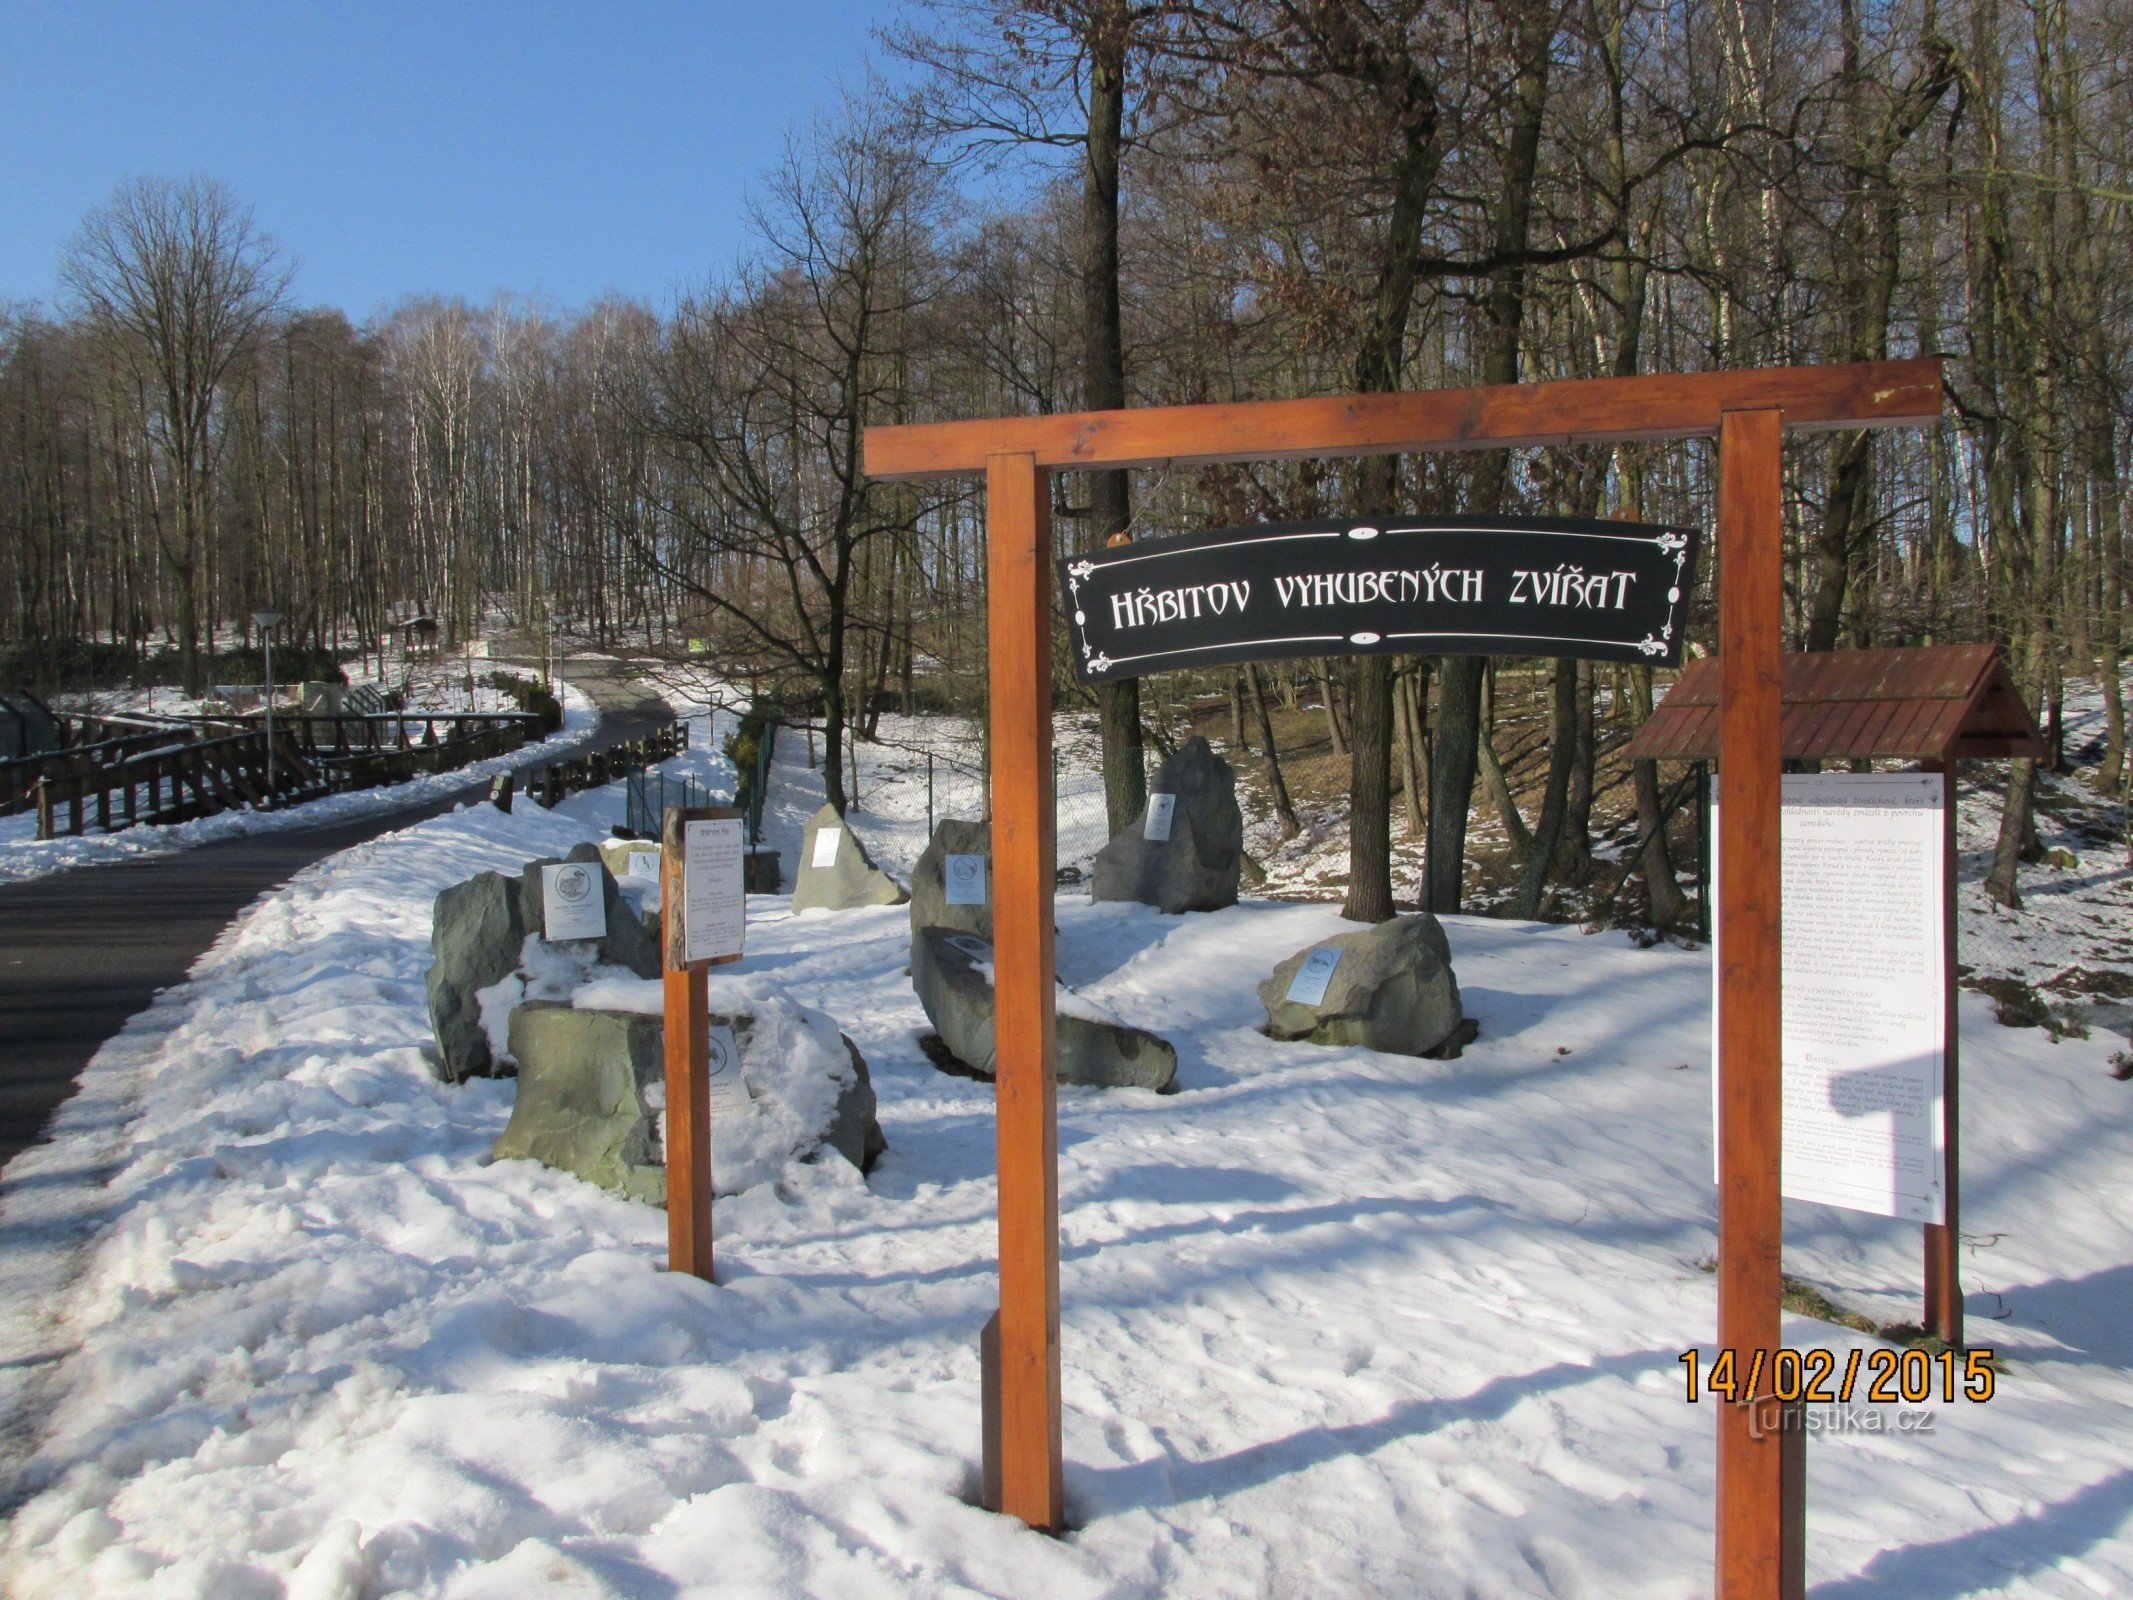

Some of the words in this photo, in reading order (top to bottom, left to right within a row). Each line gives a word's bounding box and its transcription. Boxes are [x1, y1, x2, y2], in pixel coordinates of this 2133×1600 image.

[1110, 581, 1249, 629] HŘBITOV
[1274, 562, 1483, 608] VYHUBENÝCH
[1509, 564, 1636, 609] ZVÍŘAT
